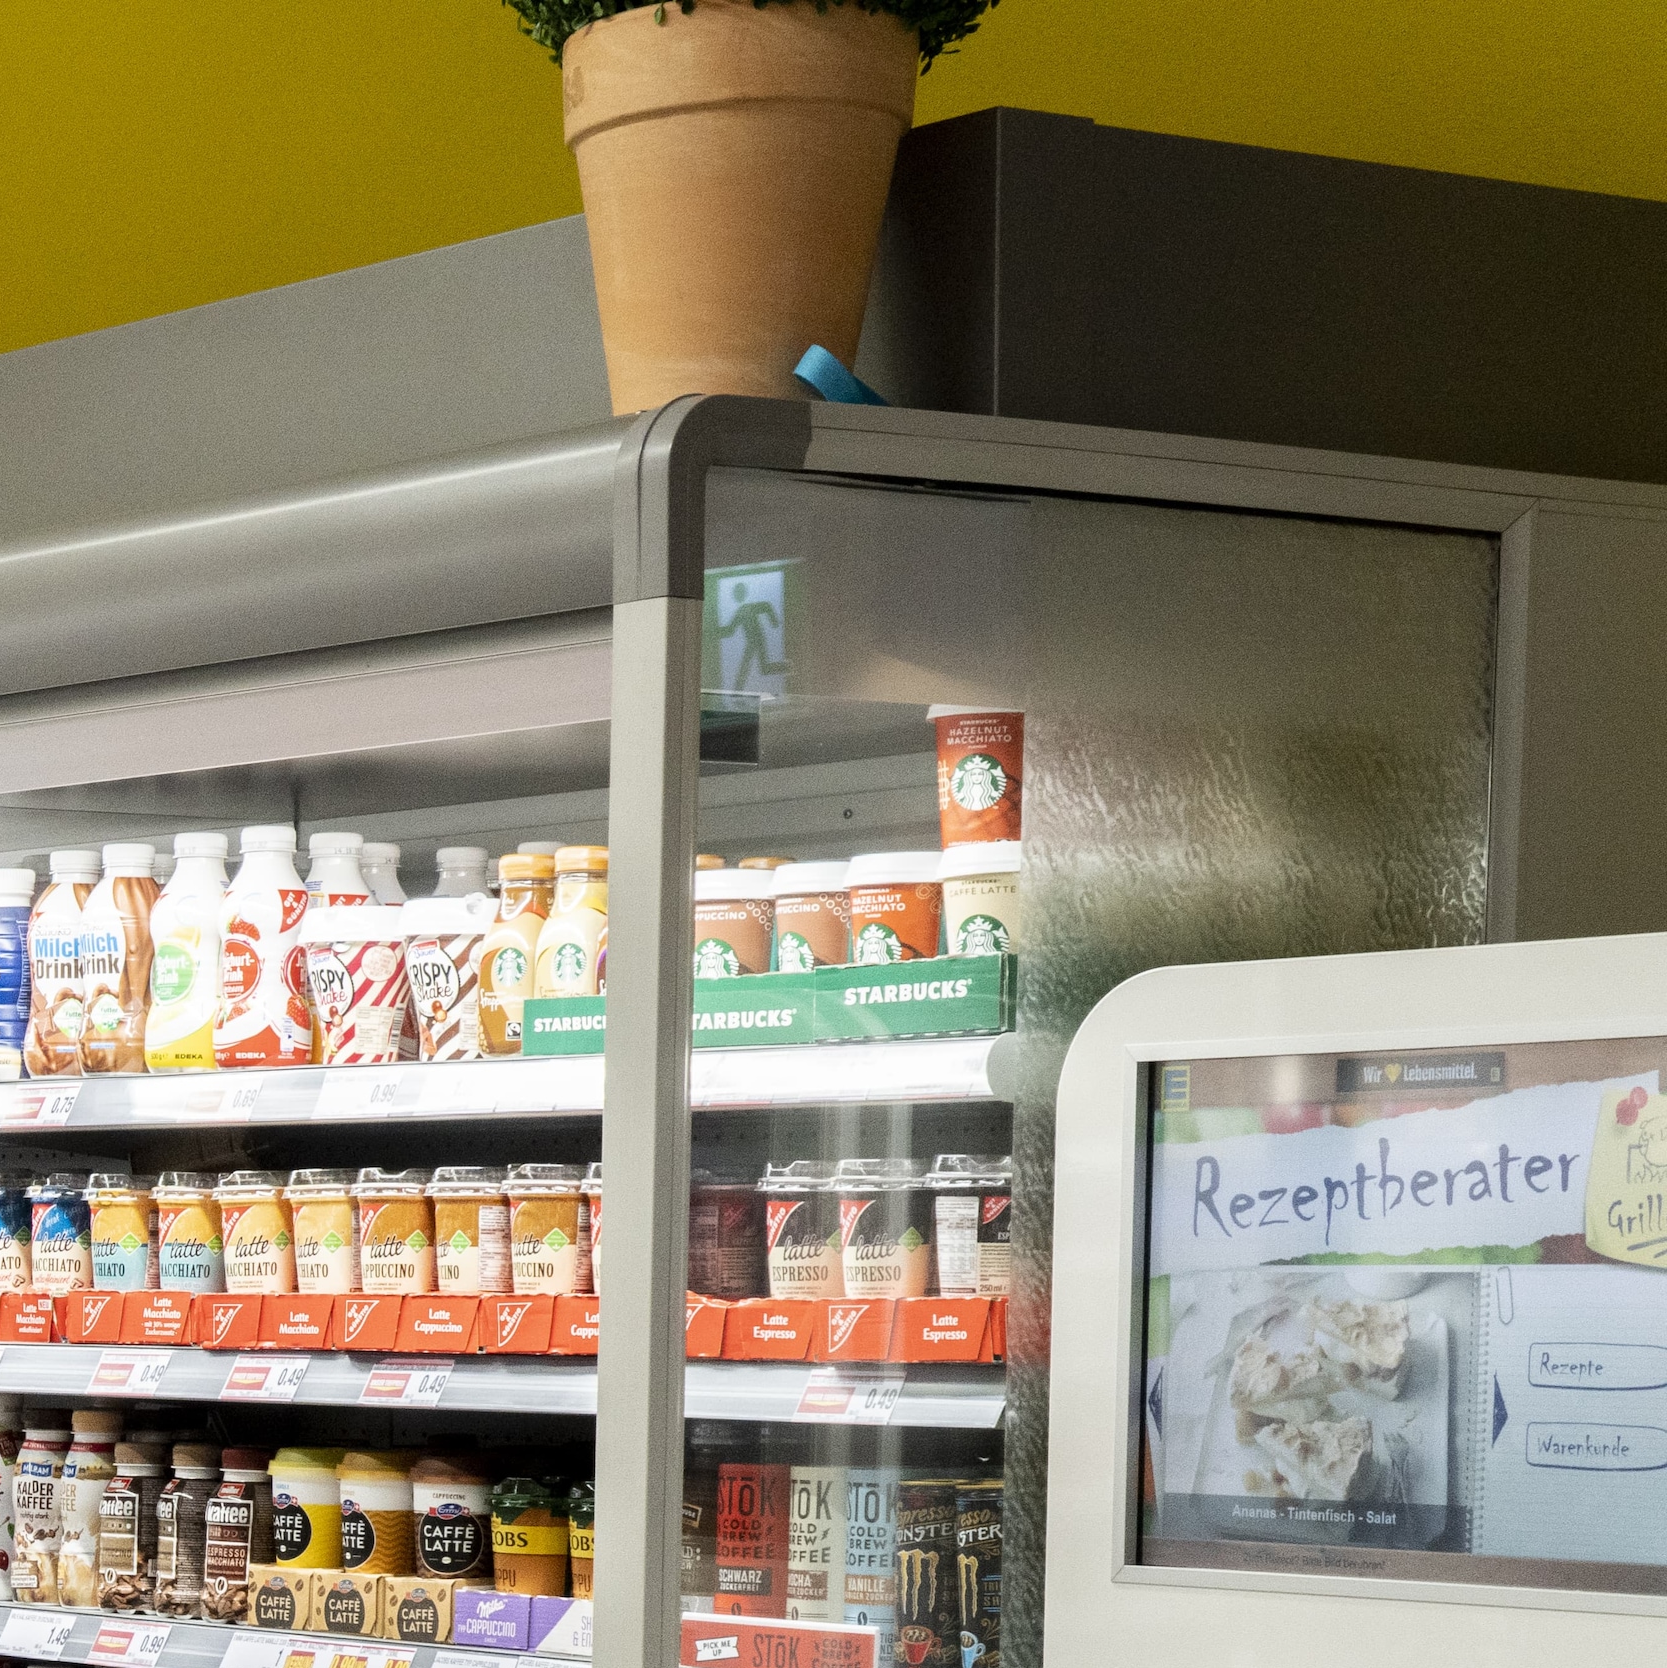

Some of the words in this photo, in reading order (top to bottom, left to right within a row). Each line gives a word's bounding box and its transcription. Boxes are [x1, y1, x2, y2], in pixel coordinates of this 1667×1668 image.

[946, 732, 1012, 745] MACCHIATO
[948, 725, 1008, 737] HAZELNUT
[984, 884, 1017, 896] LATTE
[843, 979, 967, 1006] STARBUCKS
[692, 1009, 793, 1031] TARBUCKS
[1363, 1065, 1383, 1084] Wir
[1403, 1062, 1478, 1082] Lebensmittel.
[1193, 1136, 1581, 1246] Rezeptberater
[370, 1237, 404, 1259] latte
[783, 1235, 825, 1261] latte
[773, 1266, 828, 1281] ESPRESSO
[290, 1312, 309, 1322] Latte
[428, 1308, 451, 1320] Latte
[932, 1314, 958, 1327] Latte
[279, 1324, 319, 1335] Macchiato
[414, 1320, 462, 1334] Cappuccino
[923, 1327, 967, 1341] Espresso
[1540, 1352, 1603, 1382] Rezepte
[277, 1368, 303, 1386] 0.49
[418, 1375, 445, 1394] 0.49
[1537, 1434, 1629, 1458] Warenkunde
[18, 1480, 53, 1496] KALDER
[18, 1496, 53, 1510] KAFFEE
[1232, 1505, 1276, 1519] Ananas
[1288, 1507, 1355, 1523] Tintenfisch
[1367, 1511, 1396, 1525] Salat
[425, 1538, 472, 1553] LATTE
[719, 1569, 762, 1584] SCHWARZ
[848, 1578, 886, 1590] VANILLE
[330, 1610, 359, 1624] LATTE
[467, 1619, 516, 1637] CAPPUCCINO
[140, 1635, 164, 1654] 0.99
[702, 1641, 720, 1650] PICK
[721, 1640, 731, 1648] ME
